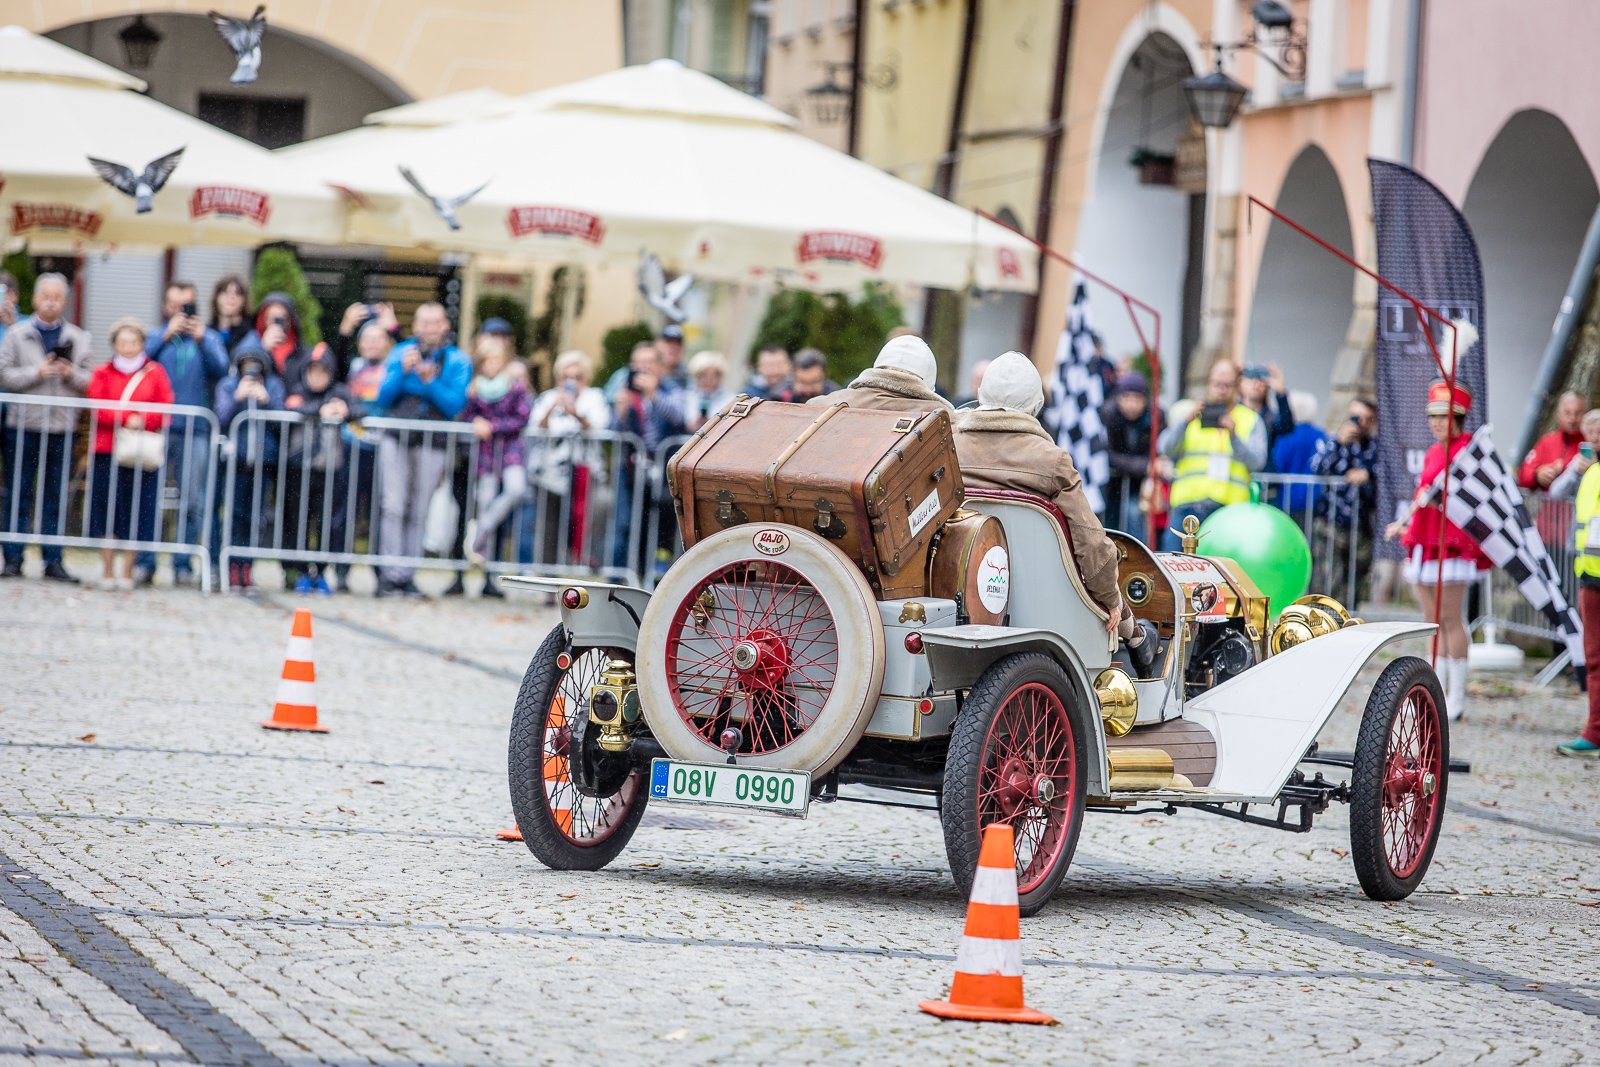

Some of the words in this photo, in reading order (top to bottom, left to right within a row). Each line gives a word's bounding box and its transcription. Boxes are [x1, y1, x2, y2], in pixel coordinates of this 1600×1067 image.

[760, 533, 783, 543] RAJO
[654, 784, 666, 794] CZ
[673, 768, 717, 797] 08V
[735, 773, 795, 804] 0990
